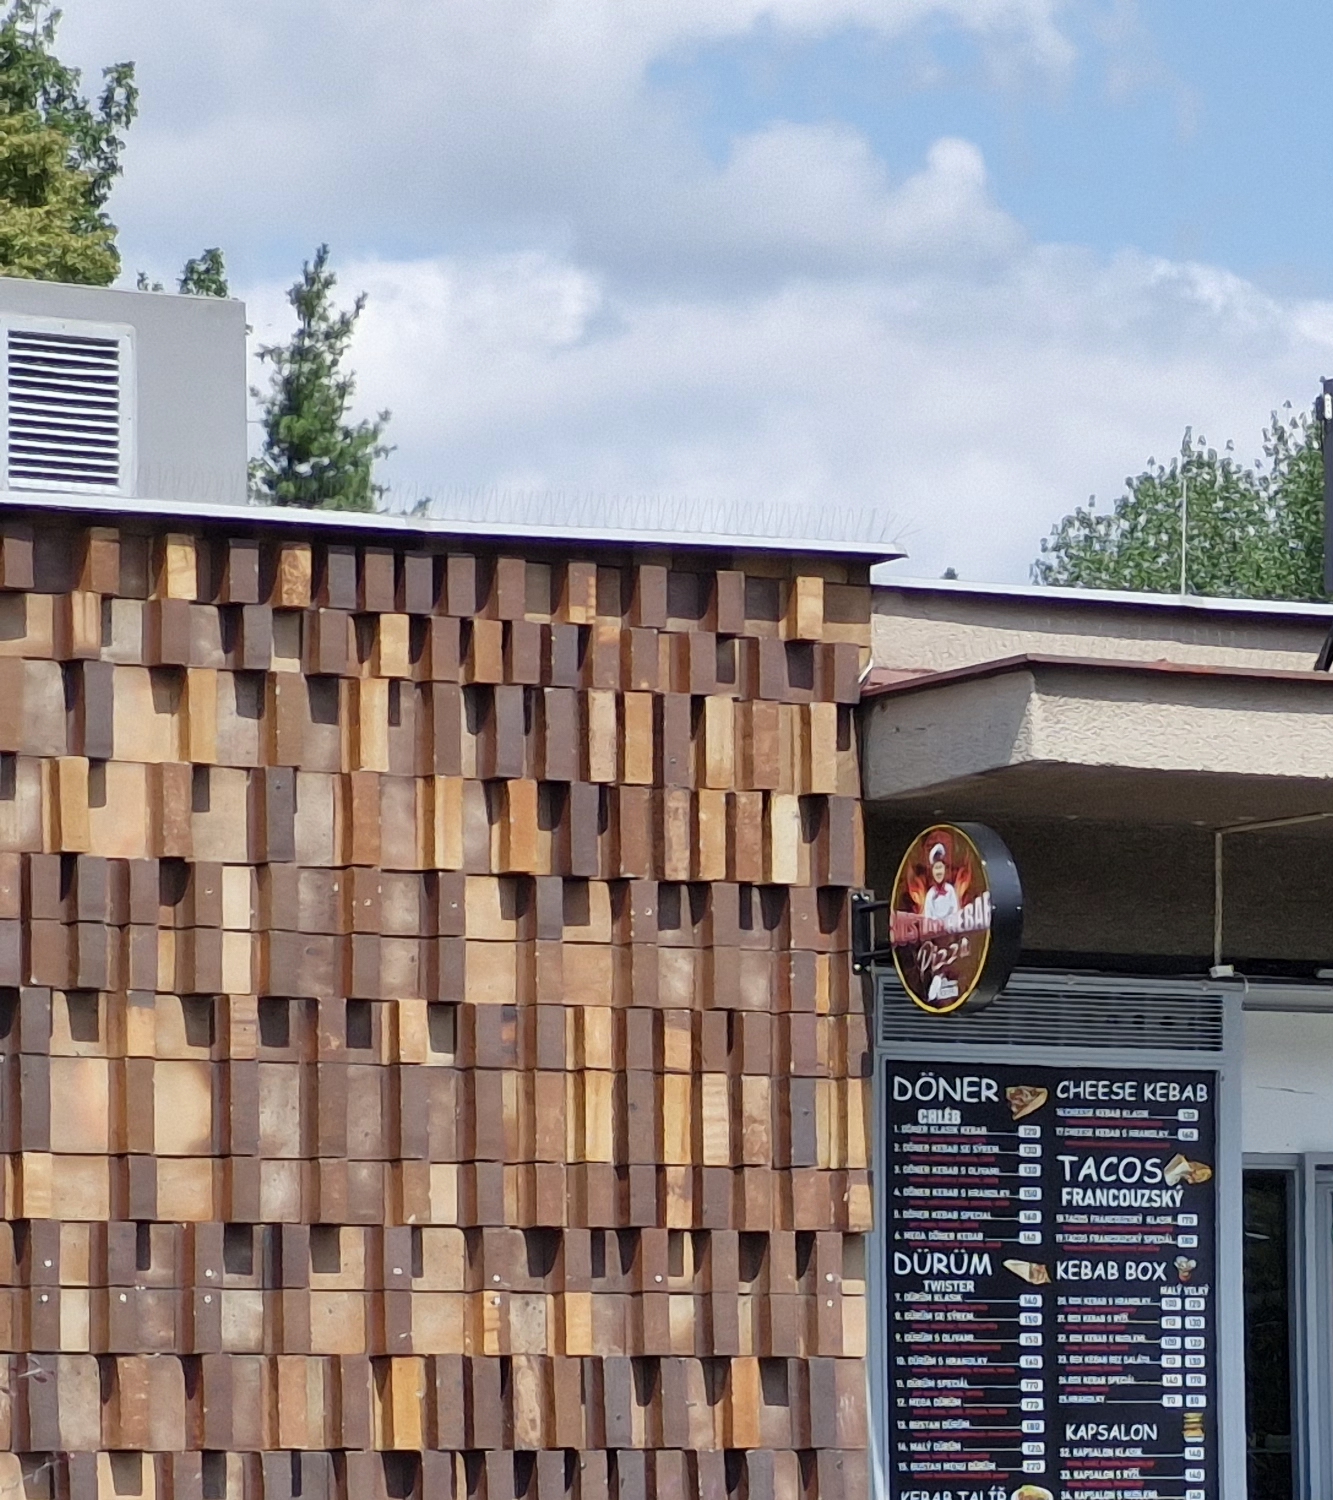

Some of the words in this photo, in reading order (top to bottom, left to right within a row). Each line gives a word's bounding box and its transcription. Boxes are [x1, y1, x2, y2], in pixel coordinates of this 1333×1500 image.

[917, 937, 970, 982] Pizza
[893, 1071, 999, 1102] DÖNER
[1056, 1080, 1138, 1101] CHEESE
[1143, 1081, 1208, 1102] KEBAB
[1056, 1154, 1163, 1184] TACOS
[1061, 1184, 1184, 1208] FRANCOUZSKÝ
[894, 1249, 993, 1276] DÜRÜM
[1056, 1260, 1119, 1281] KEBAB
[1125, 1260, 1167, 1281] BOX
[923, 1280, 975, 1293] TWISTER
[1065, 1423, 1158, 1441] KAPSALON
